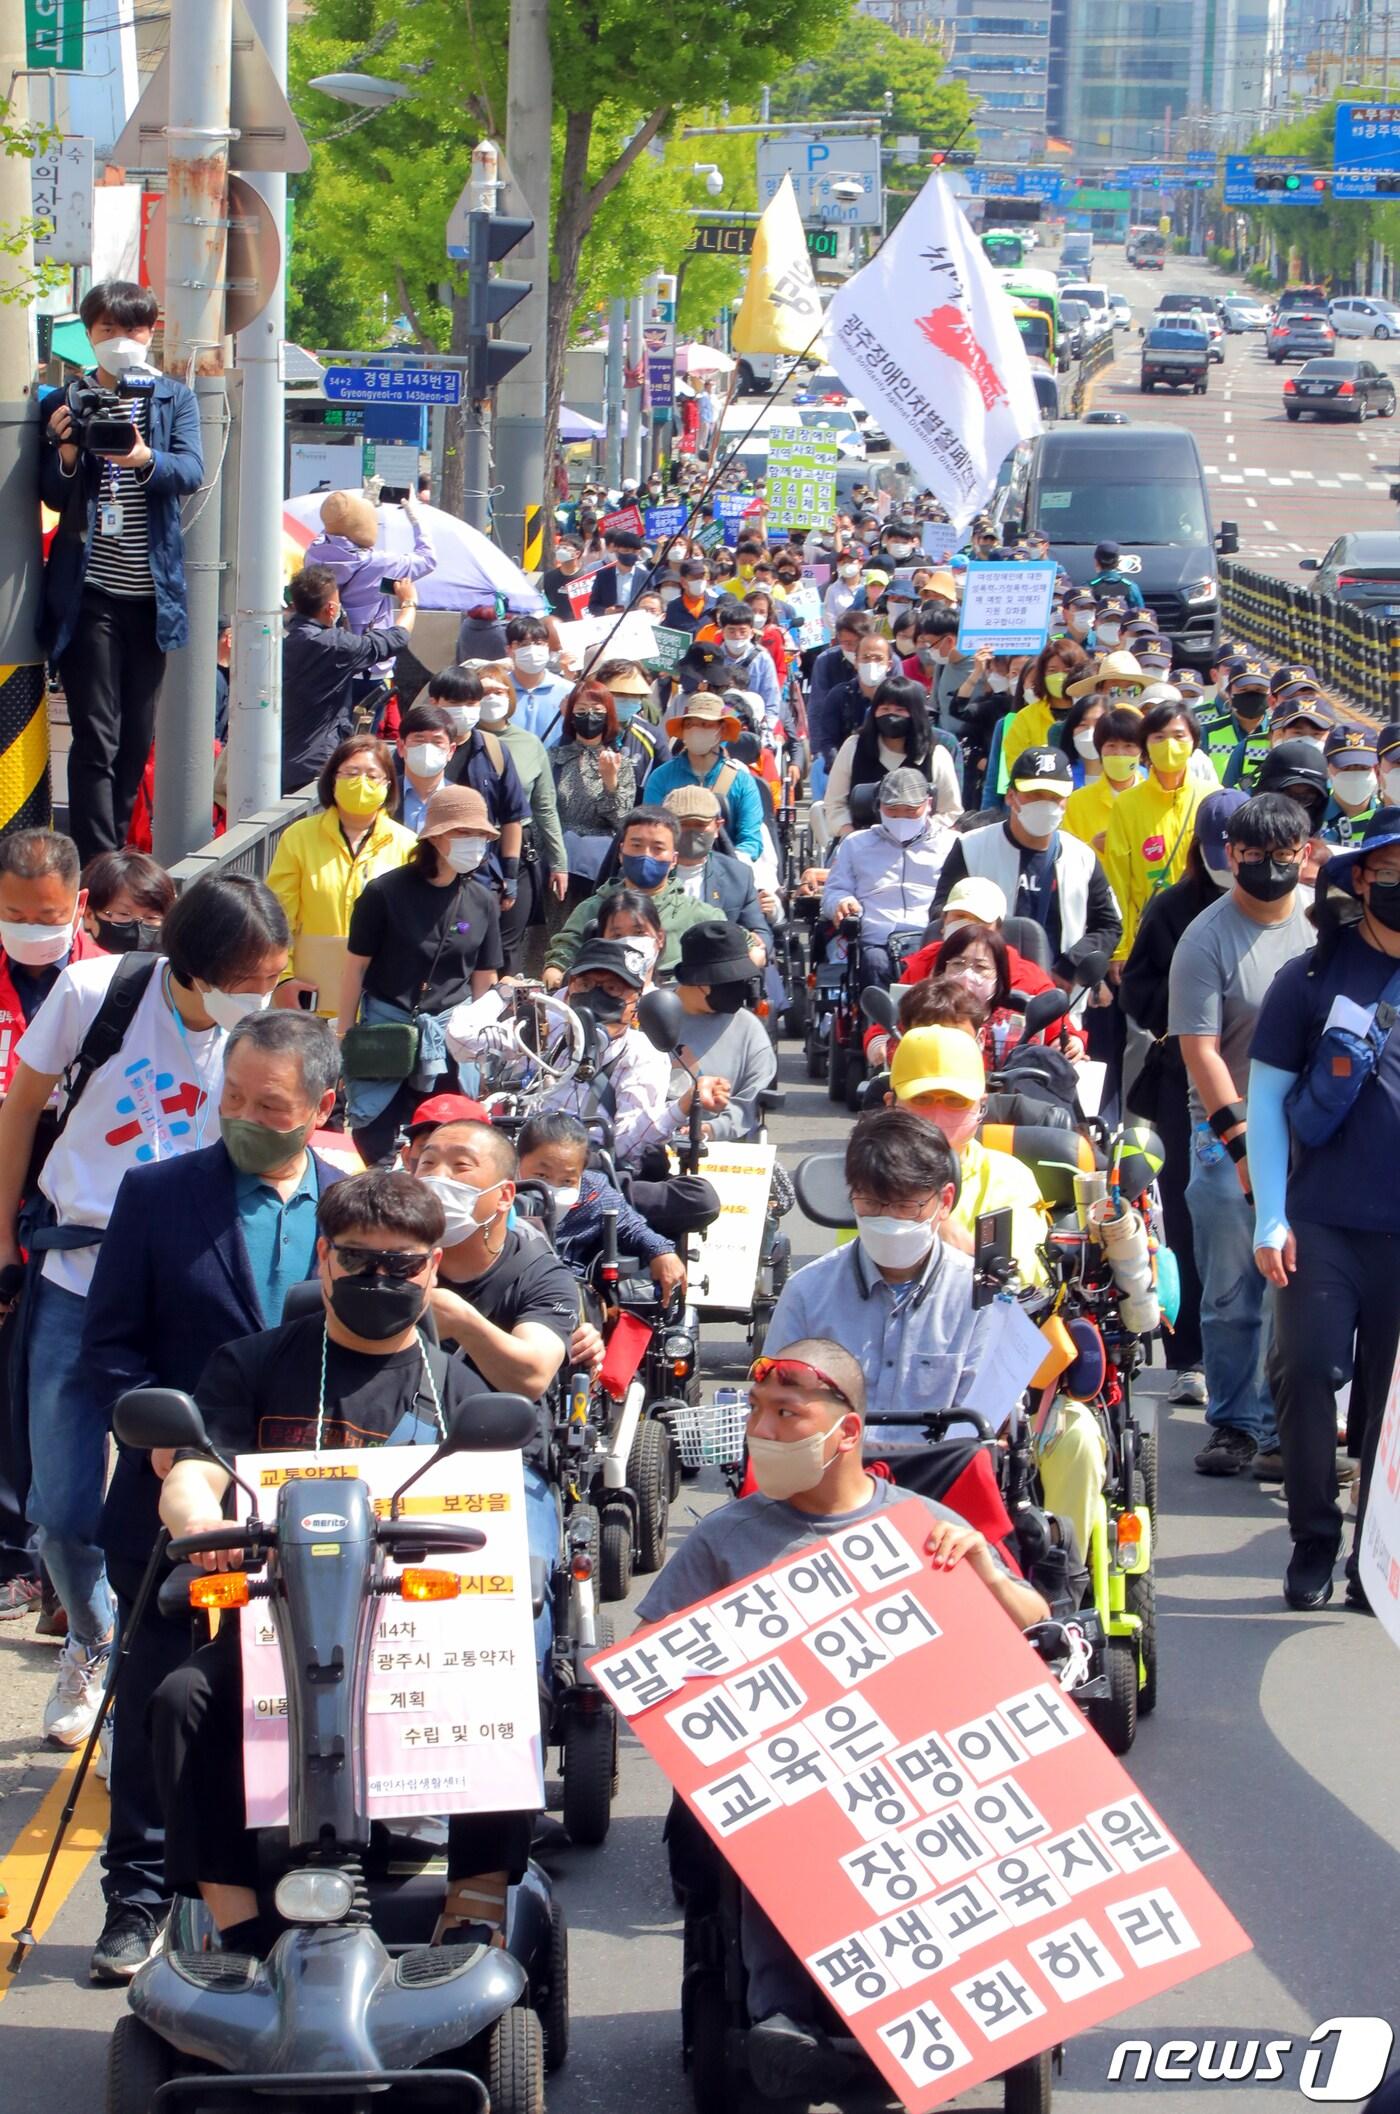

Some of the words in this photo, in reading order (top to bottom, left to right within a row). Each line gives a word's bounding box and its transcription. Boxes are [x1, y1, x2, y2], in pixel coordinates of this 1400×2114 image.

[808, 144, 829, 172] P
[364, 371, 456, 391] 경열로143번길
[340, 387, 403, 400] Gyeongyeol-ro
[1019, 873, 1041, 892] AL
[442, 1492, 506, 1513] 보장을
[312, 1519, 349, 1527] merits
[466, 1575, 514, 1594] 시오.
[602, 1521, 910, 1707] 발달장애인
[259, 1625, 275, 1642] 실
[377, 1652, 431, 1671] 광주시
[443, 1649, 516, 1667] 교통약자
[681, 1664, 801, 1746] 에게
[812, 1593, 939, 1680] 있어
[257, 1698, 288, 1716] 이동
[390, 1690, 425, 1709] 계획
[404, 1726, 440, 1745] 수립
[452, 1724, 468, 1742] 및
[480, 1722, 515, 1740] 이행
[707, 1704, 886, 1828] 교육은
[843, 1690, 1080, 1825] 생명이다
[368, 1775, 466, 1792] 애인자립생활센터
[848, 1788, 1045, 1902] 장애인
[815, 1798, 1171, 1999] 평생교육지원
[885, 1900, 1188, 2072] 강화하라
